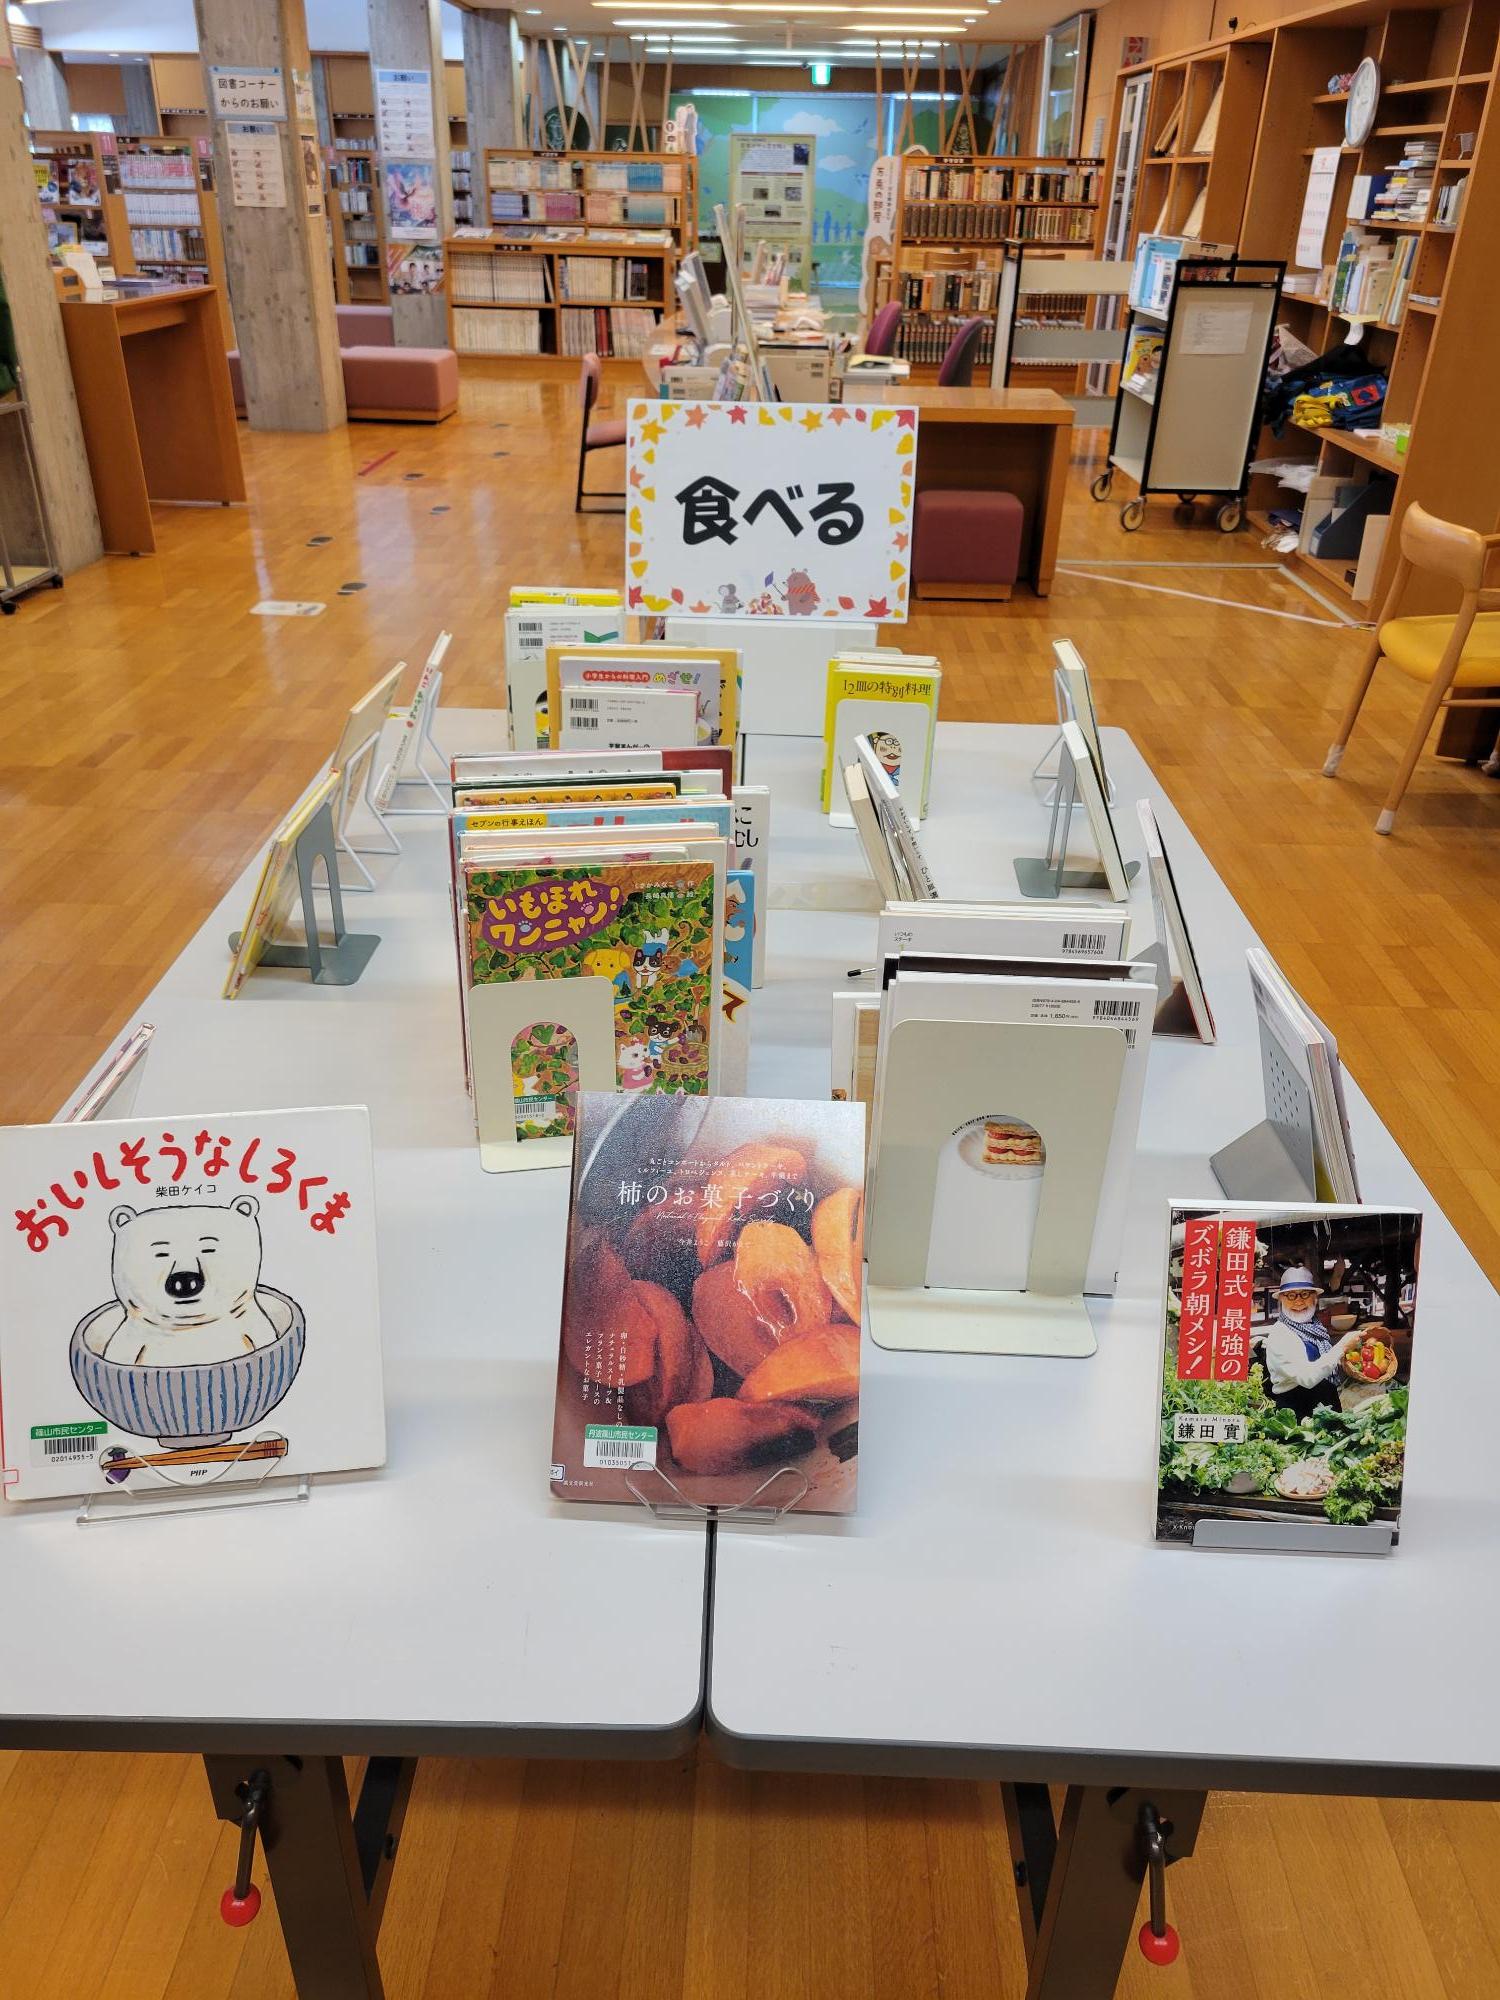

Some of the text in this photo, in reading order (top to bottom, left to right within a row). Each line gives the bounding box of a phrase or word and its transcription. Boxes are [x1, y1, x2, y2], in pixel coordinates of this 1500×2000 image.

[218, 78, 277, 90] 図書コーナー
[220, 98, 279, 109] からのお願い
[675, 475, 864, 546] 食べる
[844, 680, 931, 698] 12皿の特別料理
[488, 880, 598, 921] いもほれ
[16, 1130, 352, 1252] おいしそうなしろくま
[156, 1185, 216, 1198] 柴田ケイコ
[617, 1180, 816, 1213] 柿のお菓子づくり
[1184, 1224, 1214, 1375] ズボラ朝メシ!
[1220, 1226, 1252, 1376] 鎌田式 最強の
[35, 1425, 103, 1436] 篠山市民センター
[588, 1429, 654, 1439] 丹波篠山市民センター
[1178, 1422, 1215, 1439] 鎌田
